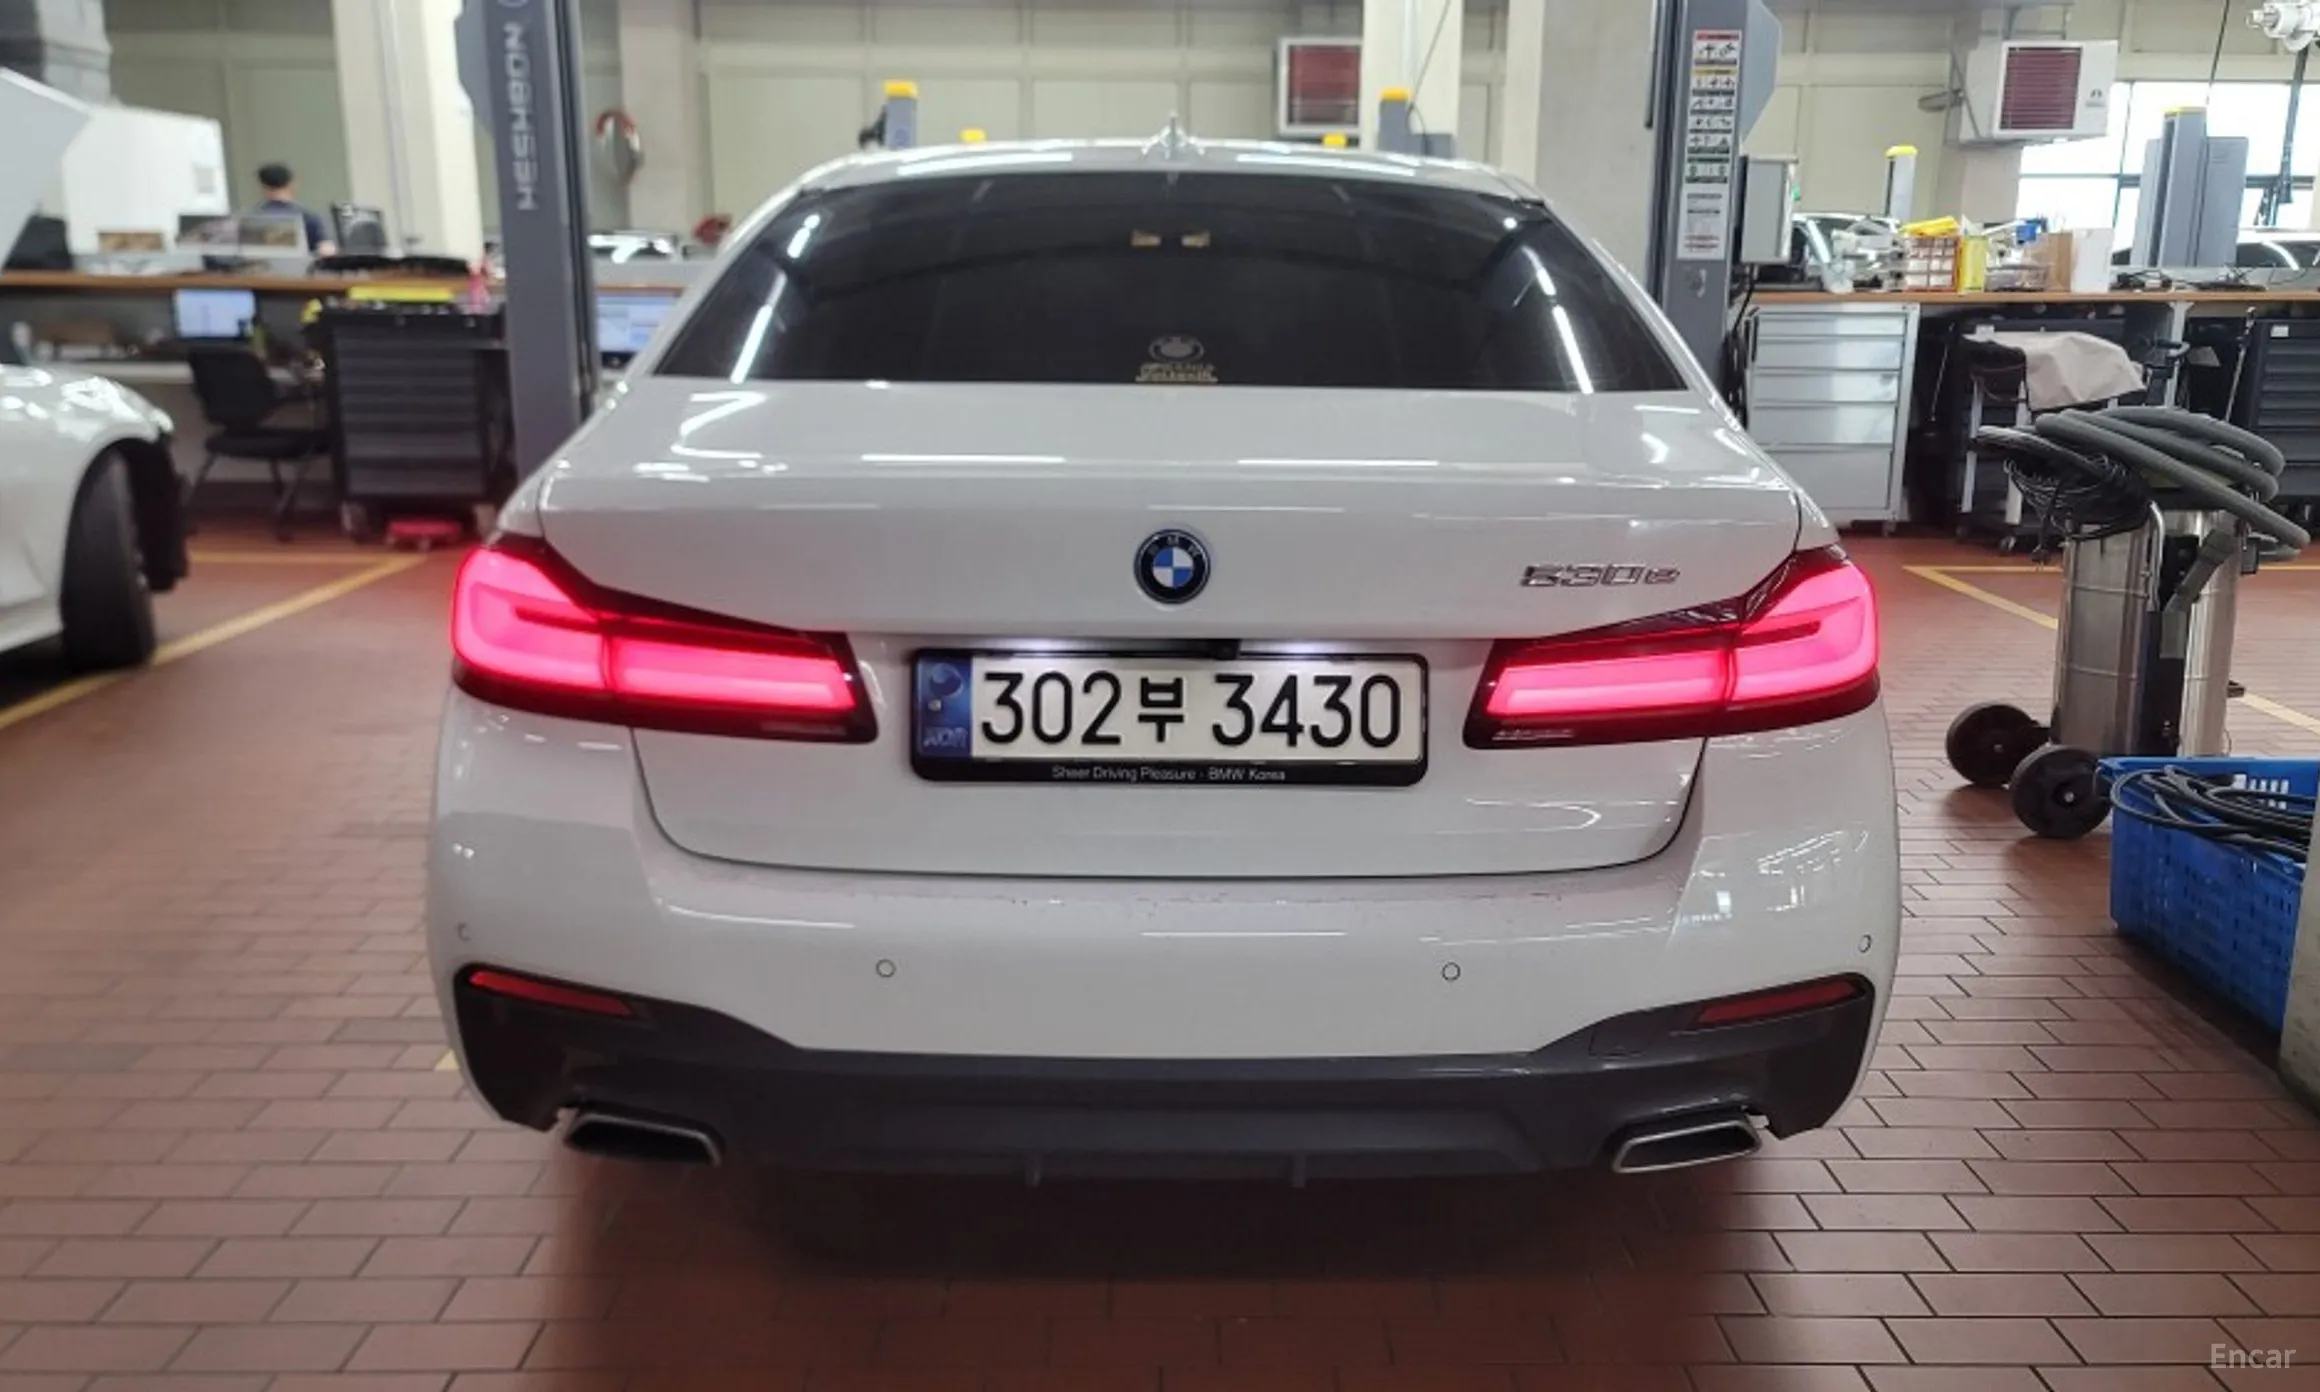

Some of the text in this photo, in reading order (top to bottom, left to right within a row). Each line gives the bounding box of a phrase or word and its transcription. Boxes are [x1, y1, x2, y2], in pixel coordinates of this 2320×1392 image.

[503, 21, 538, 211] HESHBON
[981, 671, 1401, 748] 302부 3430
[1051, 765, 1286, 784] Sheer Driving Pleasure BMW Korea
